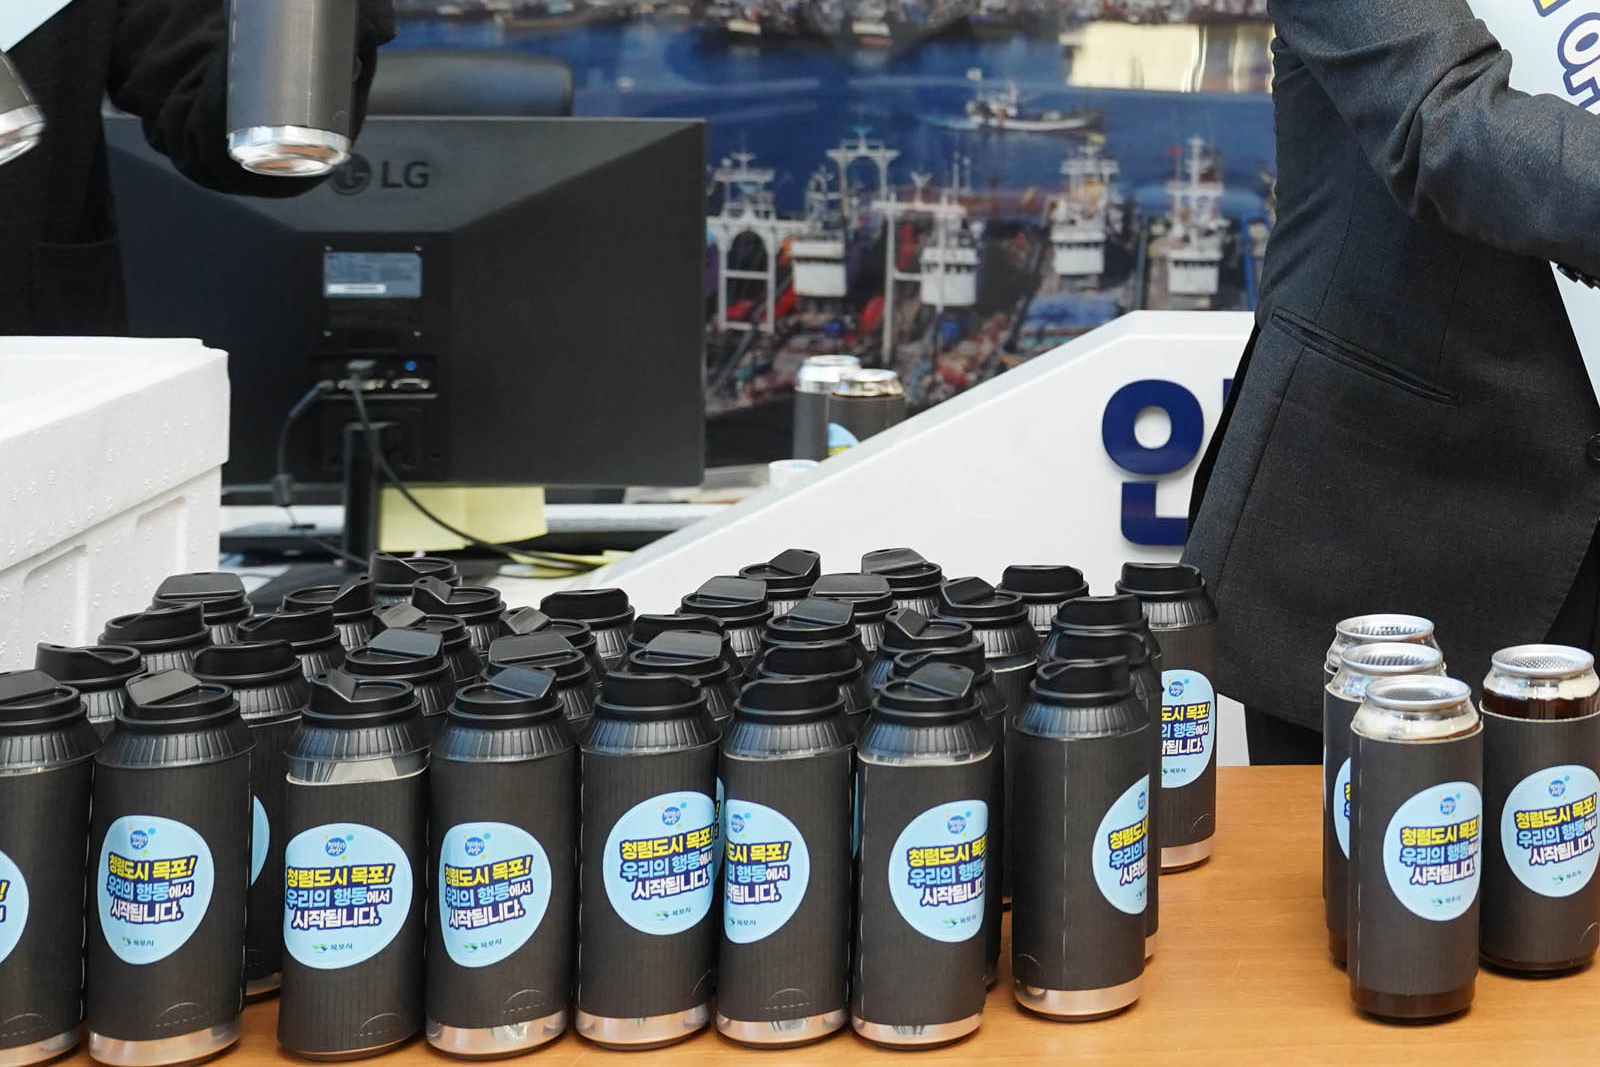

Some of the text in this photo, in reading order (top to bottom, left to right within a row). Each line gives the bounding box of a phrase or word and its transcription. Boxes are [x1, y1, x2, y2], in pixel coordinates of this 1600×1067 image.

[381, 160, 430, 189] LG
[1162, 705, 1185, 722] 도시
[1515, 793, 1597, 829] 청렴도시 목포!
[620, 835, 683, 861] 청렴도시
[1401, 824, 1457, 847] 청렴도시
[1517, 827, 1560, 849] 우리의
[750, 840, 791, 864] 목포!
[907, 843, 969, 868] 청렴도시
[1109, 841, 1144, 870] 우리의
[1400, 846, 1445, 867] 우리의
[108, 852, 198, 881] 청렴도시 목포!
[287, 863, 395, 888] 청렴도시 목포!
[445, 855, 533, 887] 청렴도시 목포!
[621, 858, 669, 881] 우리의
[736, 863, 790, 884] 행동에서
[908, 867, 956, 888] 우리의
[107, 875, 194, 903] 우리의 행동에서
[445, 878, 533, 908] 우리의 행동에서
[632, 869, 710, 900] 시작됩니다.
[286, 886, 392, 909] 우리의 행동에서
[111, 899, 184, 924] 시작됩니다.
[291, 906, 382, 930] 시작됩니다.
[449, 898, 526, 929] 시작됩니다.
